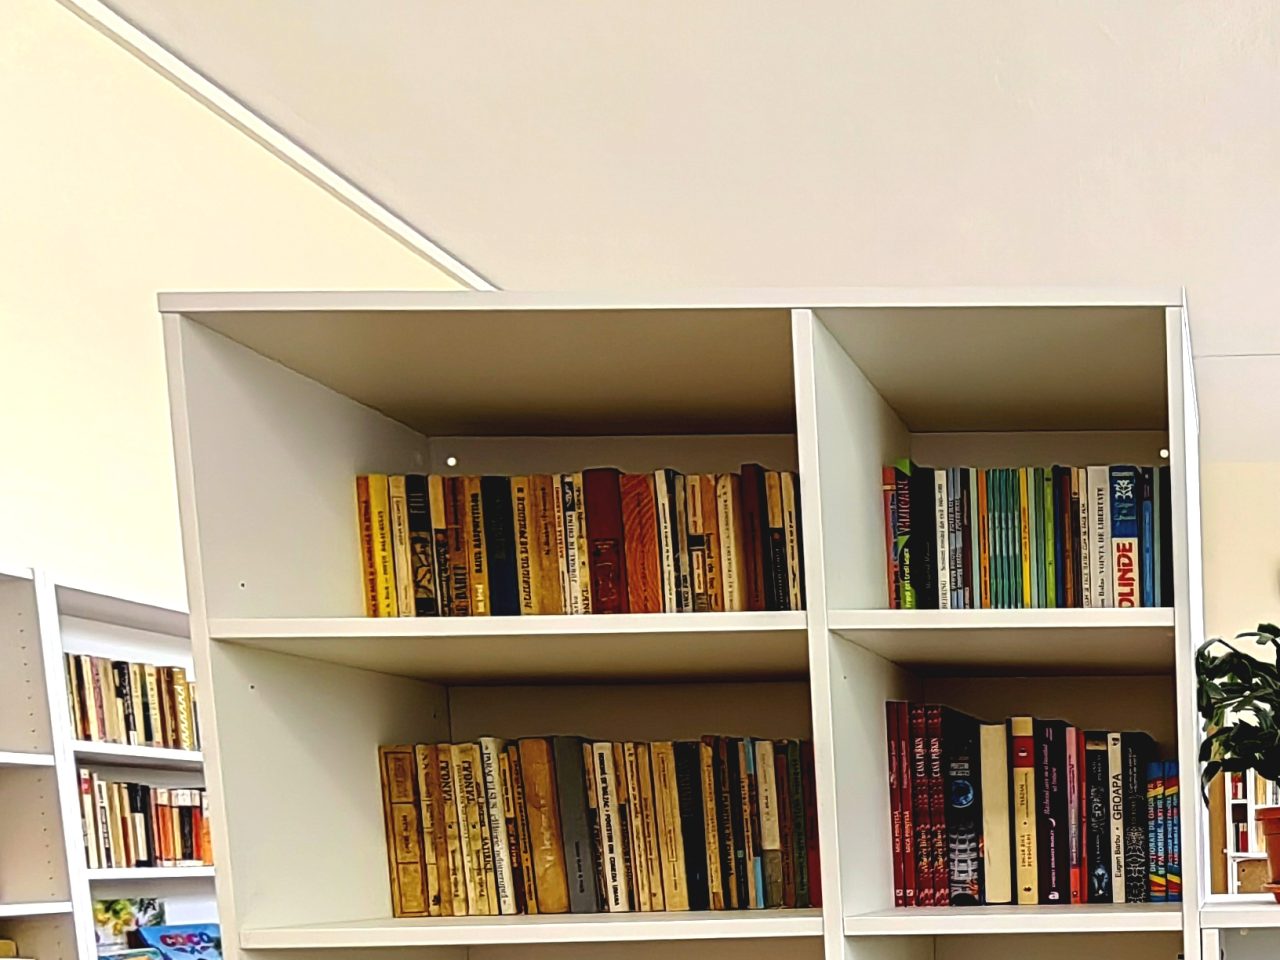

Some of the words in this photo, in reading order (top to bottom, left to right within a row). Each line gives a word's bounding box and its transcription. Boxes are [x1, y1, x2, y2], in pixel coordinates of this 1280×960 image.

[1097, 487, 1105, 530] LIBERTATE
[567, 513, 575, 539] CHINA
[1098, 531, 1105, 543] DE
[600, 785, 610, 809] BALZAC
[1112, 773, 1122, 821] GROAPA
[1114, 856, 1123, 878] Eugen
